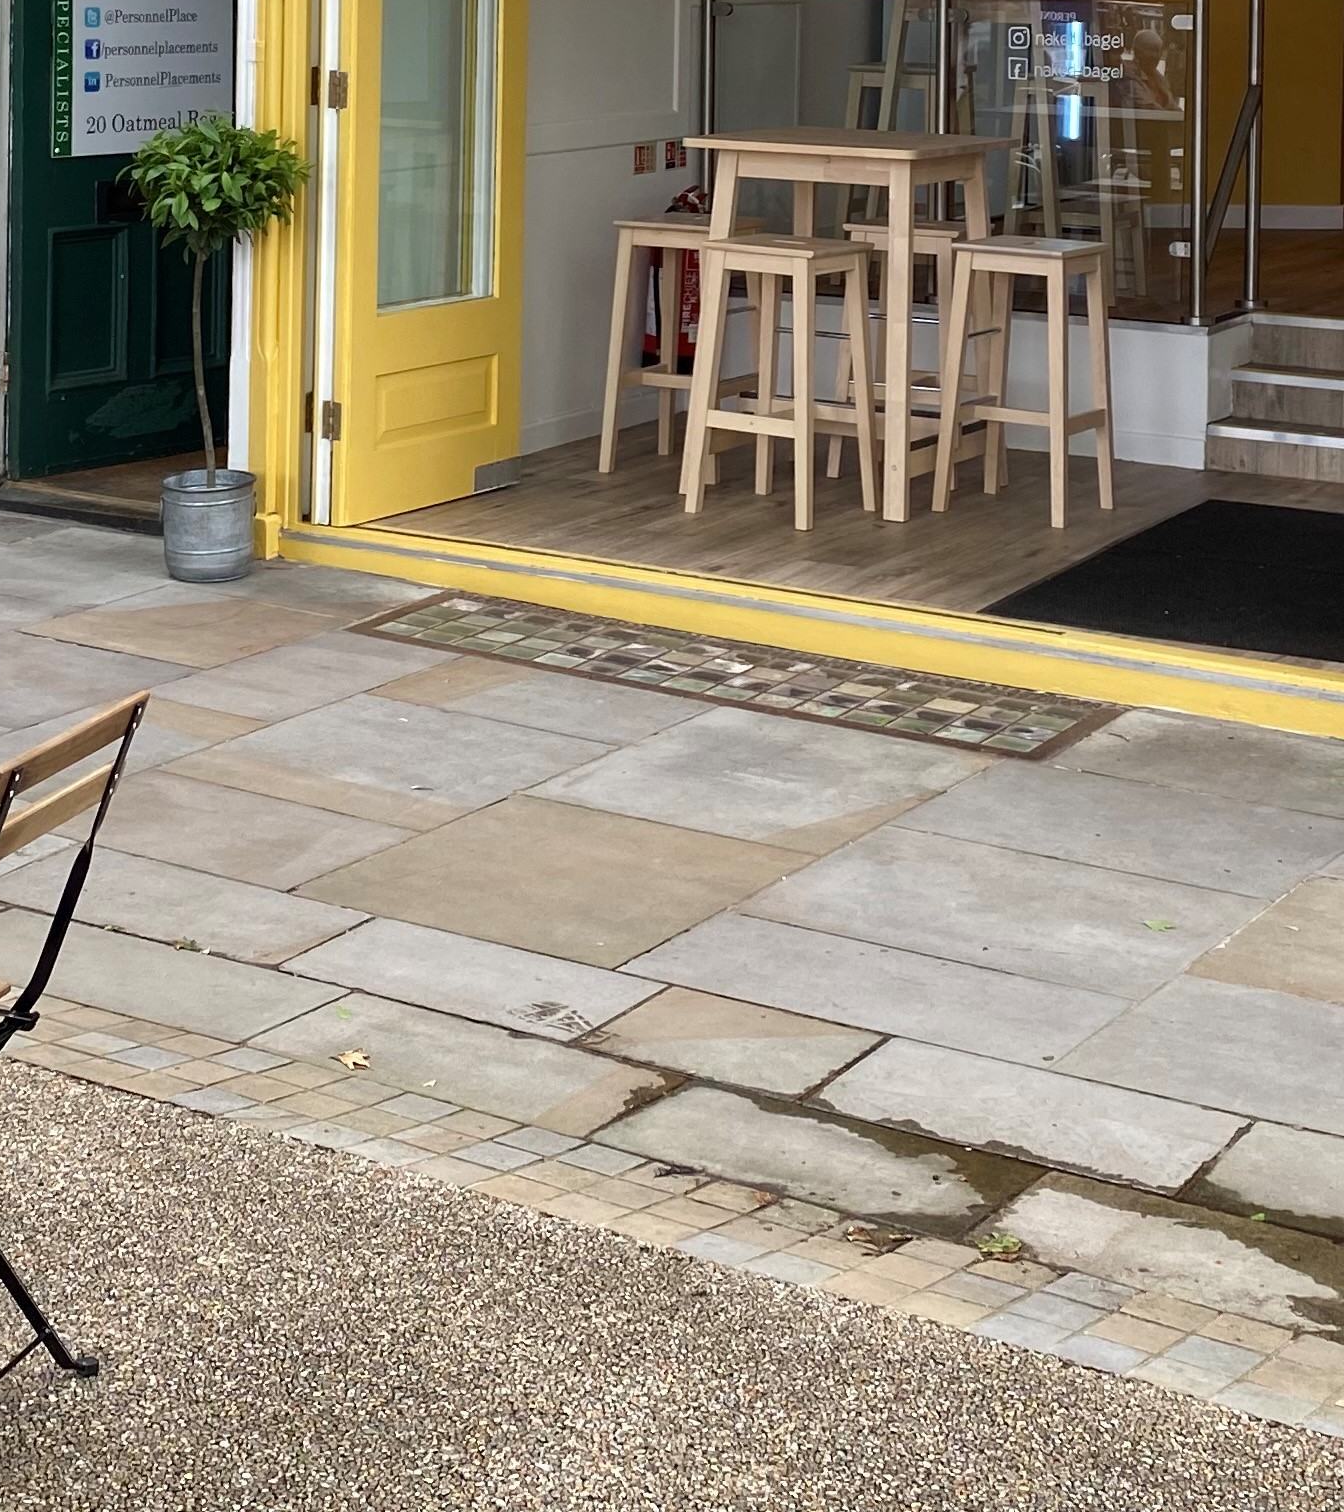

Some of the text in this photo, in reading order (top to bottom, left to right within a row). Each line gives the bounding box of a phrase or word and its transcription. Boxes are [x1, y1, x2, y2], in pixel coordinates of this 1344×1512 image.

[105, 8, 197, 25] @PersonnelPlace
[102, 41, 218, 58] /personnelplacements
[105, 72, 221, 88] PersonnelPlacements
[86, 115, 106, 134] 20
[112, 111, 181, 132] Oatmeal
